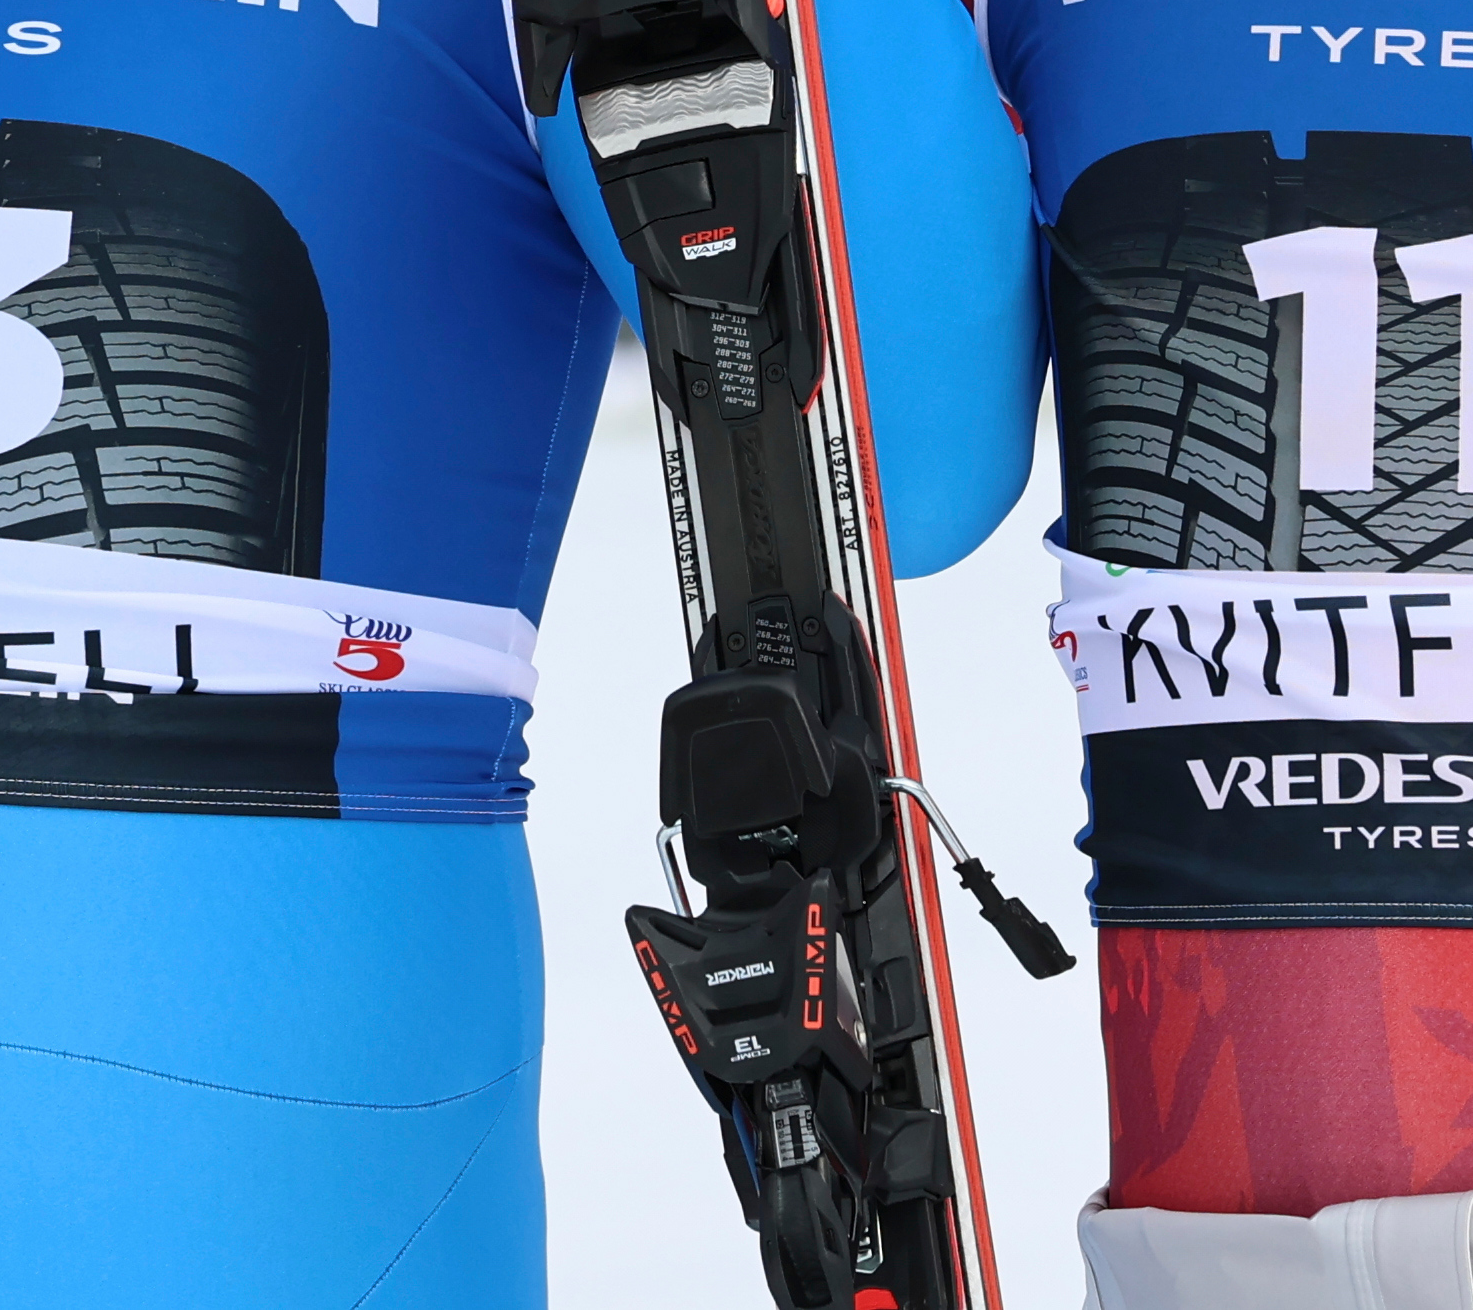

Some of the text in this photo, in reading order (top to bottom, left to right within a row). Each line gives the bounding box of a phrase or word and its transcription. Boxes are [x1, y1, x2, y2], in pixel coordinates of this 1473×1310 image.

[680, 226, 736, 247] GRIP
[685, 239, 734, 257] WALK
[829, 436, 860, 551] ART. 827610
[665, 449, 700, 604] MADE IN AUSTRIA
[333, 637, 406, 681] 5
[705, 961, 775, 987] MARKER
[734, 1034, 762, 1052] 13
[730, 1048, 771, 1063] COMP
